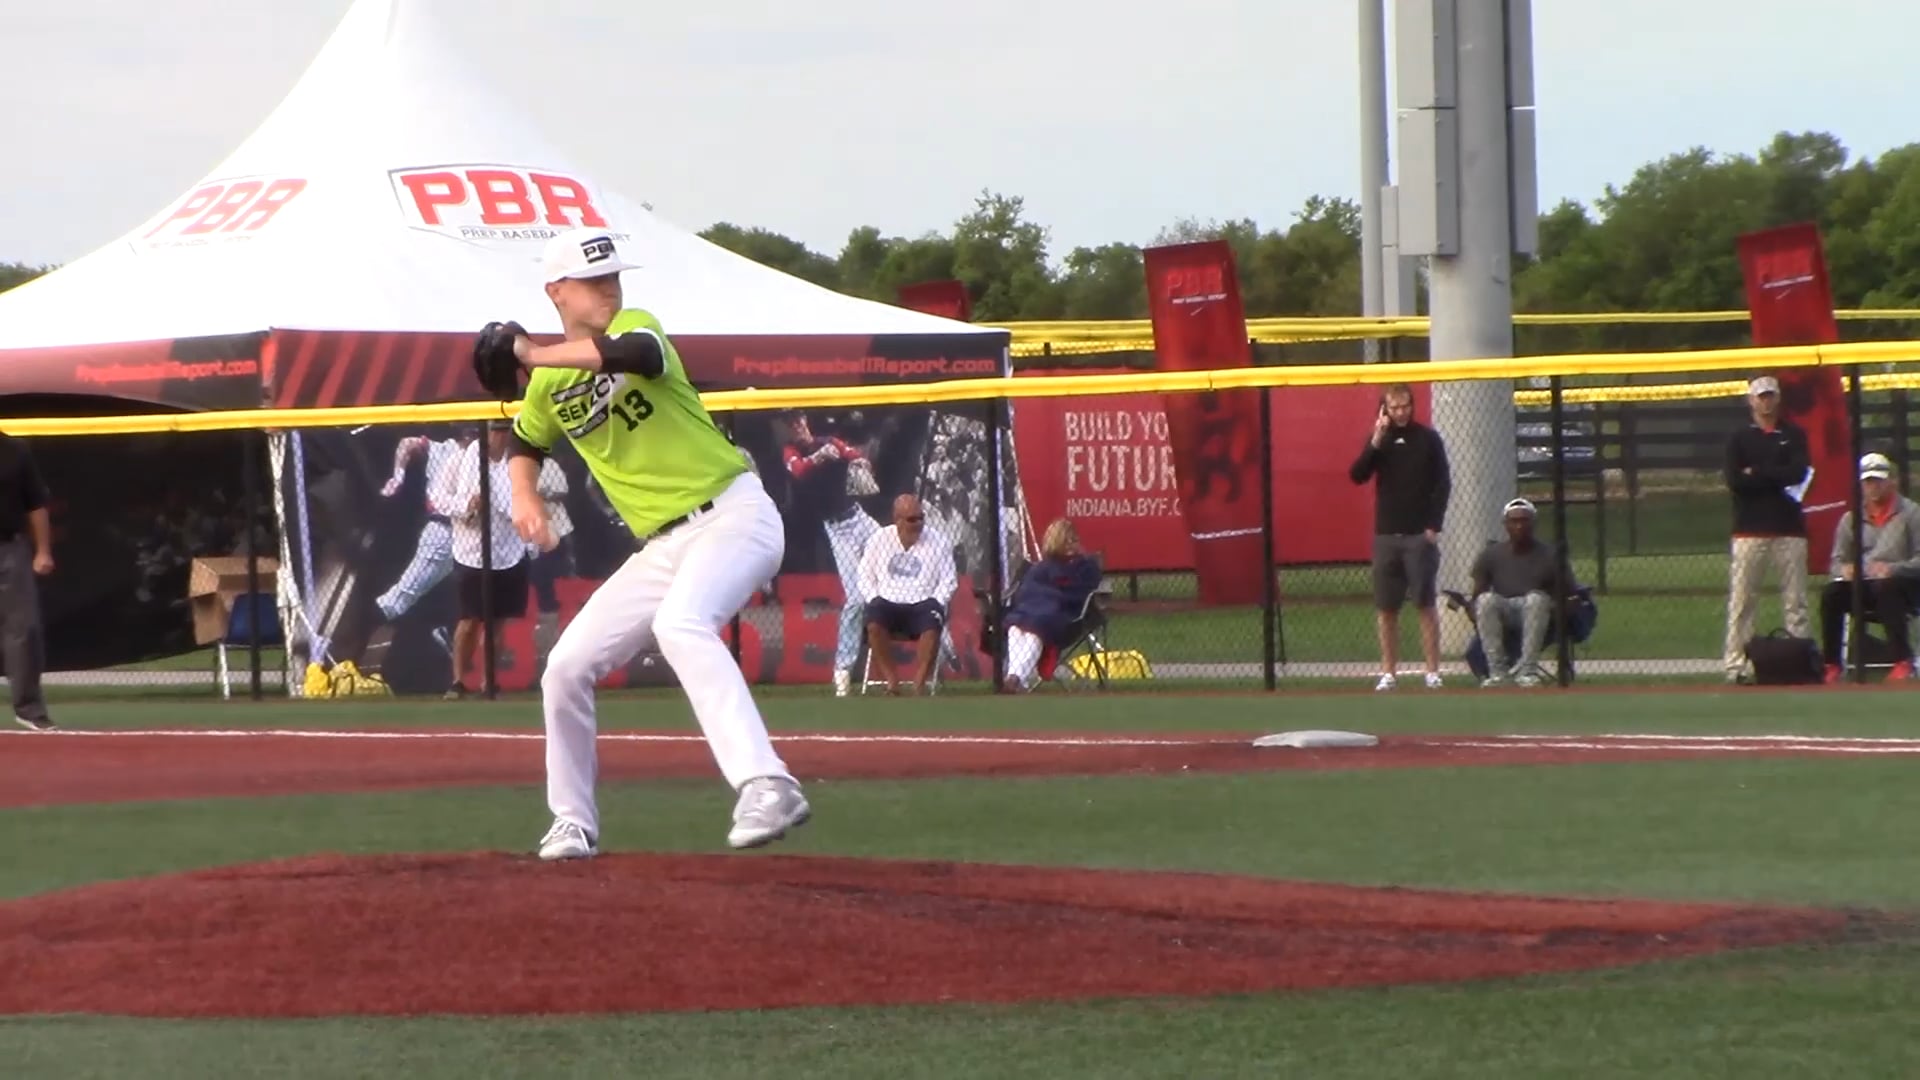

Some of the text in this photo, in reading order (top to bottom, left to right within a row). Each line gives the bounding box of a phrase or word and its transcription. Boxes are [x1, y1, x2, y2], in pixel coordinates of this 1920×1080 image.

[142, 178, 308, 239] PBR
[400, 170, 609, 227] PBR
[461, 228, 497, 239] PREP
[502, 229, 562, 240] BASEBA
[612, 389, 654, 432] 13
[1065, 411, 1169, 441] BUILD YO
[1067, 445, 1177, 491] FUTUR
[1067, 497, 1182, 517] INDIANA.BYF.C
